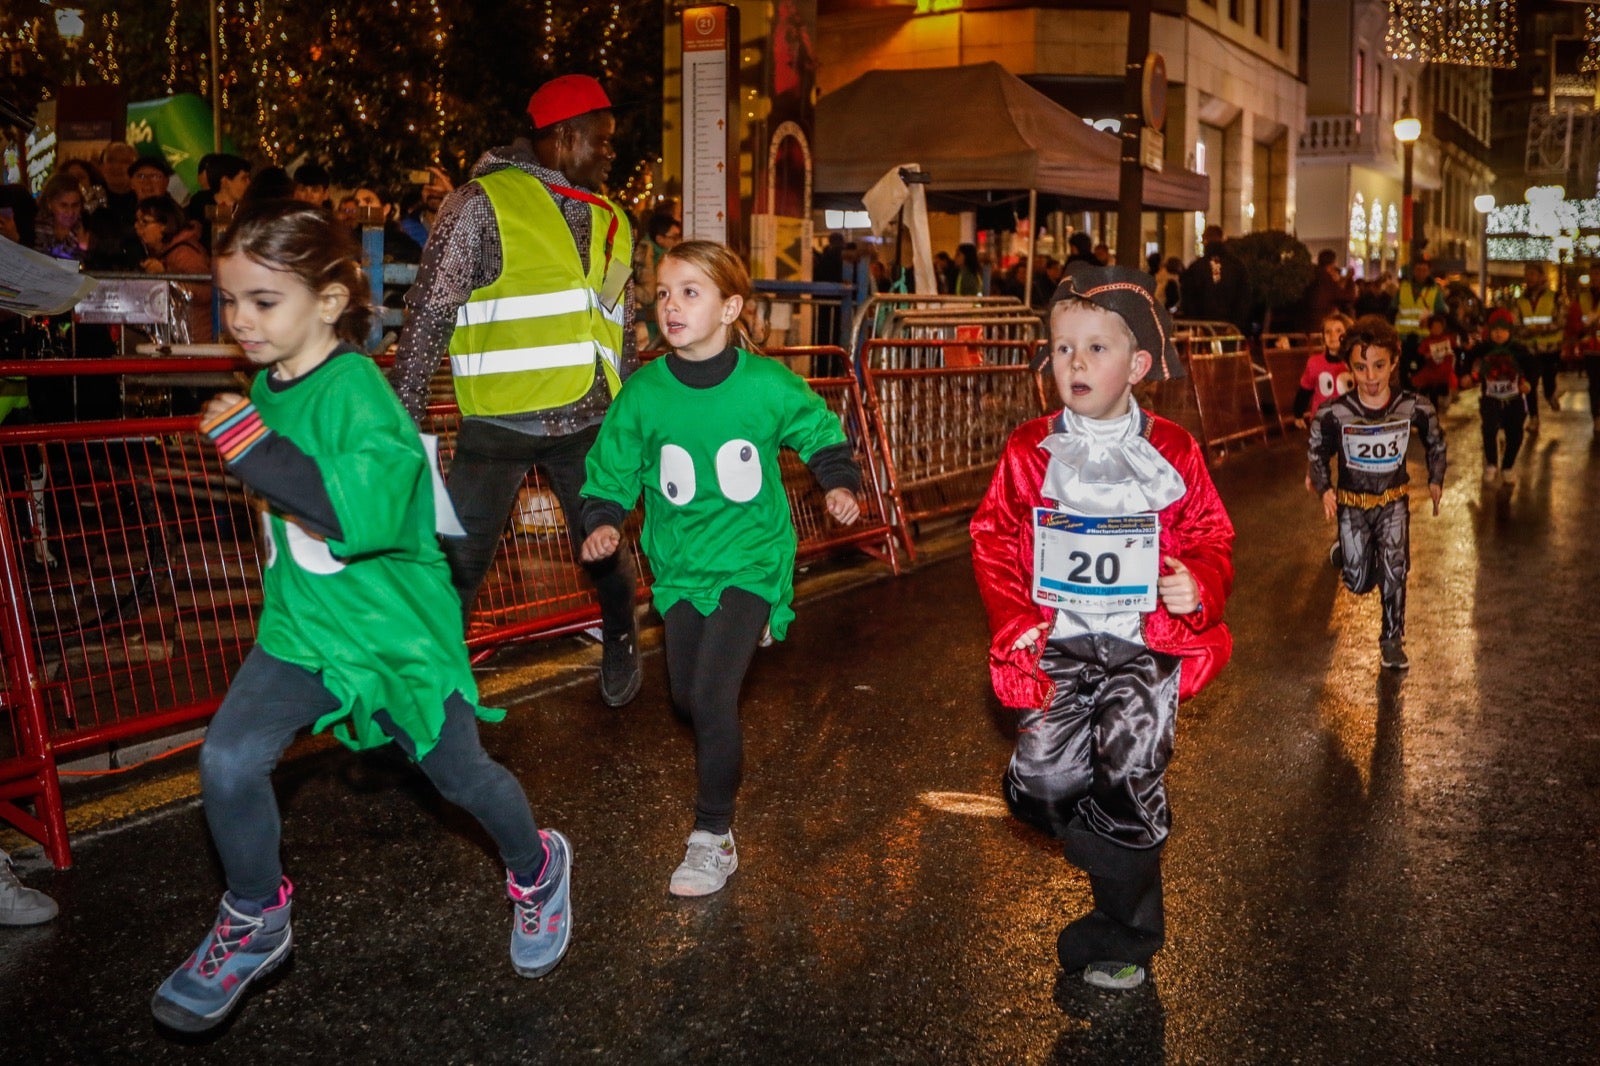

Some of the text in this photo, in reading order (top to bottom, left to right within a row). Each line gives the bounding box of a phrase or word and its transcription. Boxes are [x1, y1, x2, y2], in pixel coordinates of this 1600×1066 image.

[699, 18, 712, 28] 21
[1357, 441, 1399, 459] 203
[1067, 550, 1121, 585] 20
